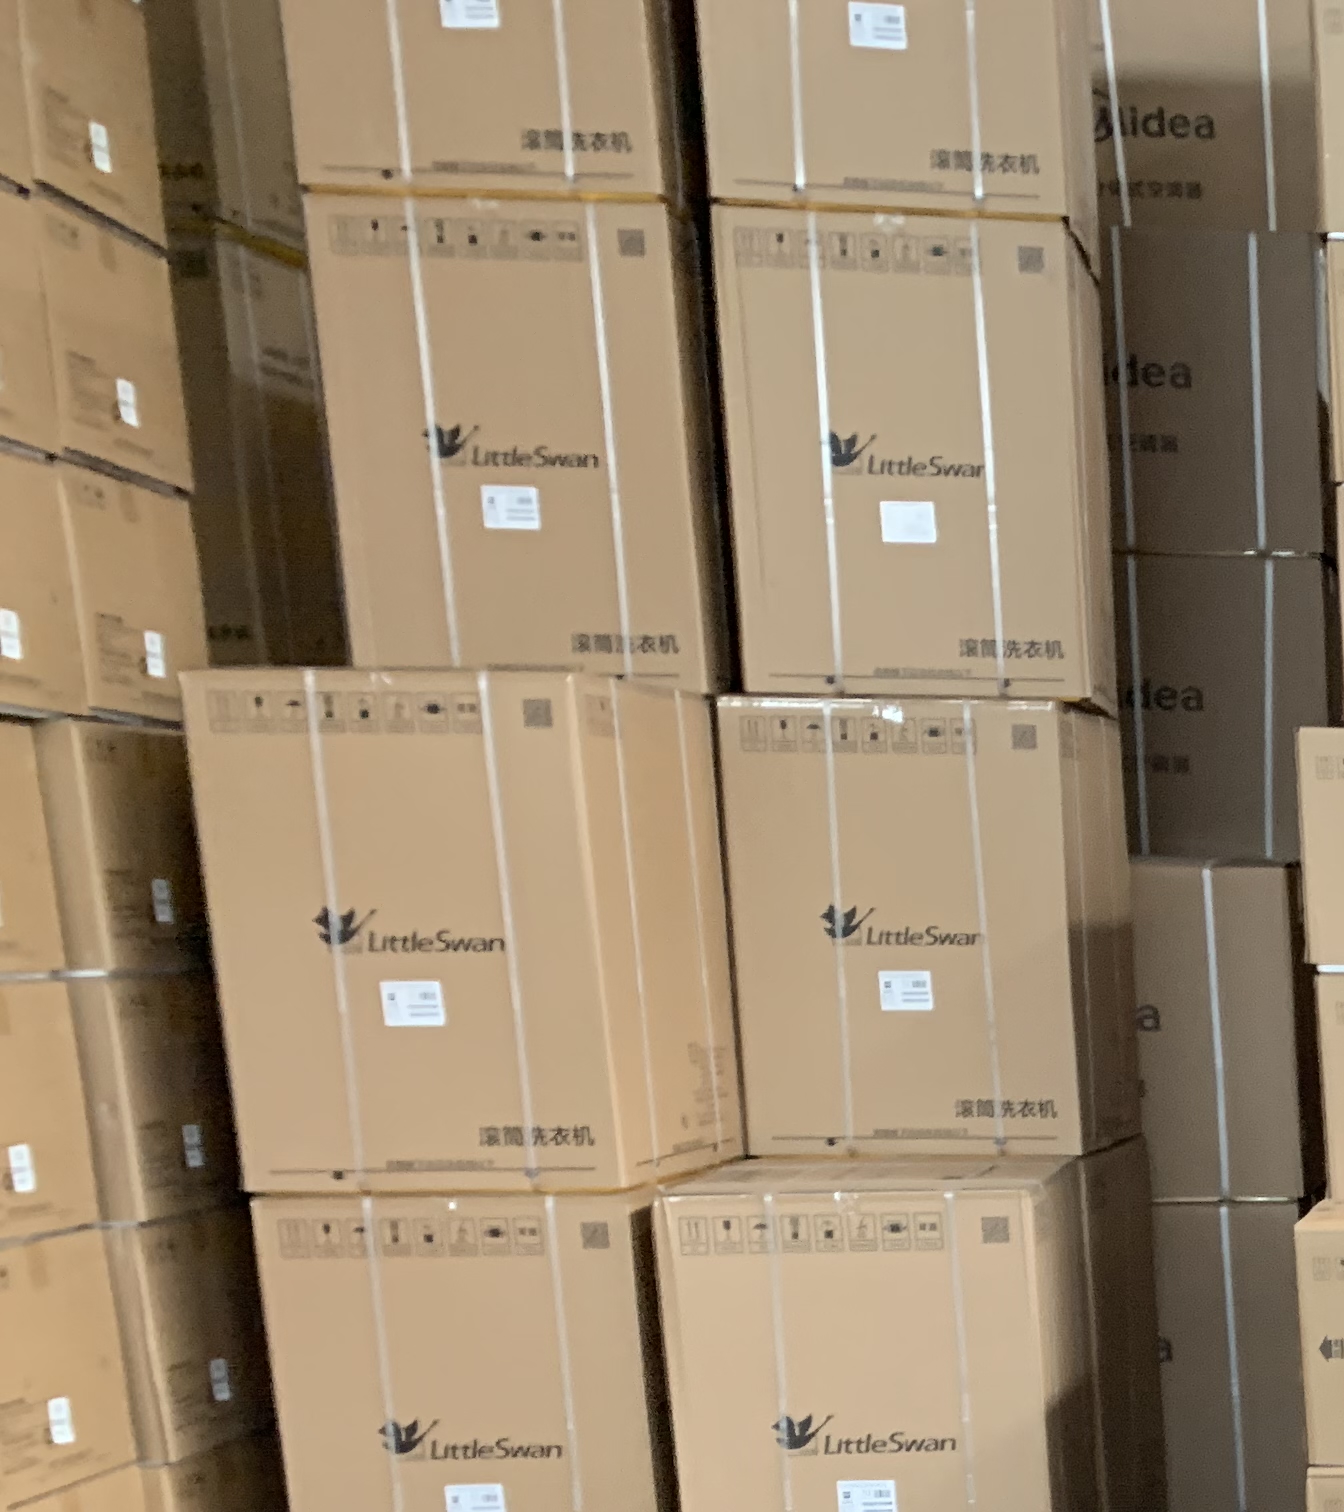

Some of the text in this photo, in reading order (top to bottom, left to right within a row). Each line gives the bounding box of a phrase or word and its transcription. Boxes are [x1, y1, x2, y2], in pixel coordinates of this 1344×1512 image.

[471, 445, 599, 468] LittleSwan
[367, 929, 505, 954] LittleSwan
[430, 1438, 564, 1461] LittleSwan
[824, 1431, 957, 1456] LittleSwan
